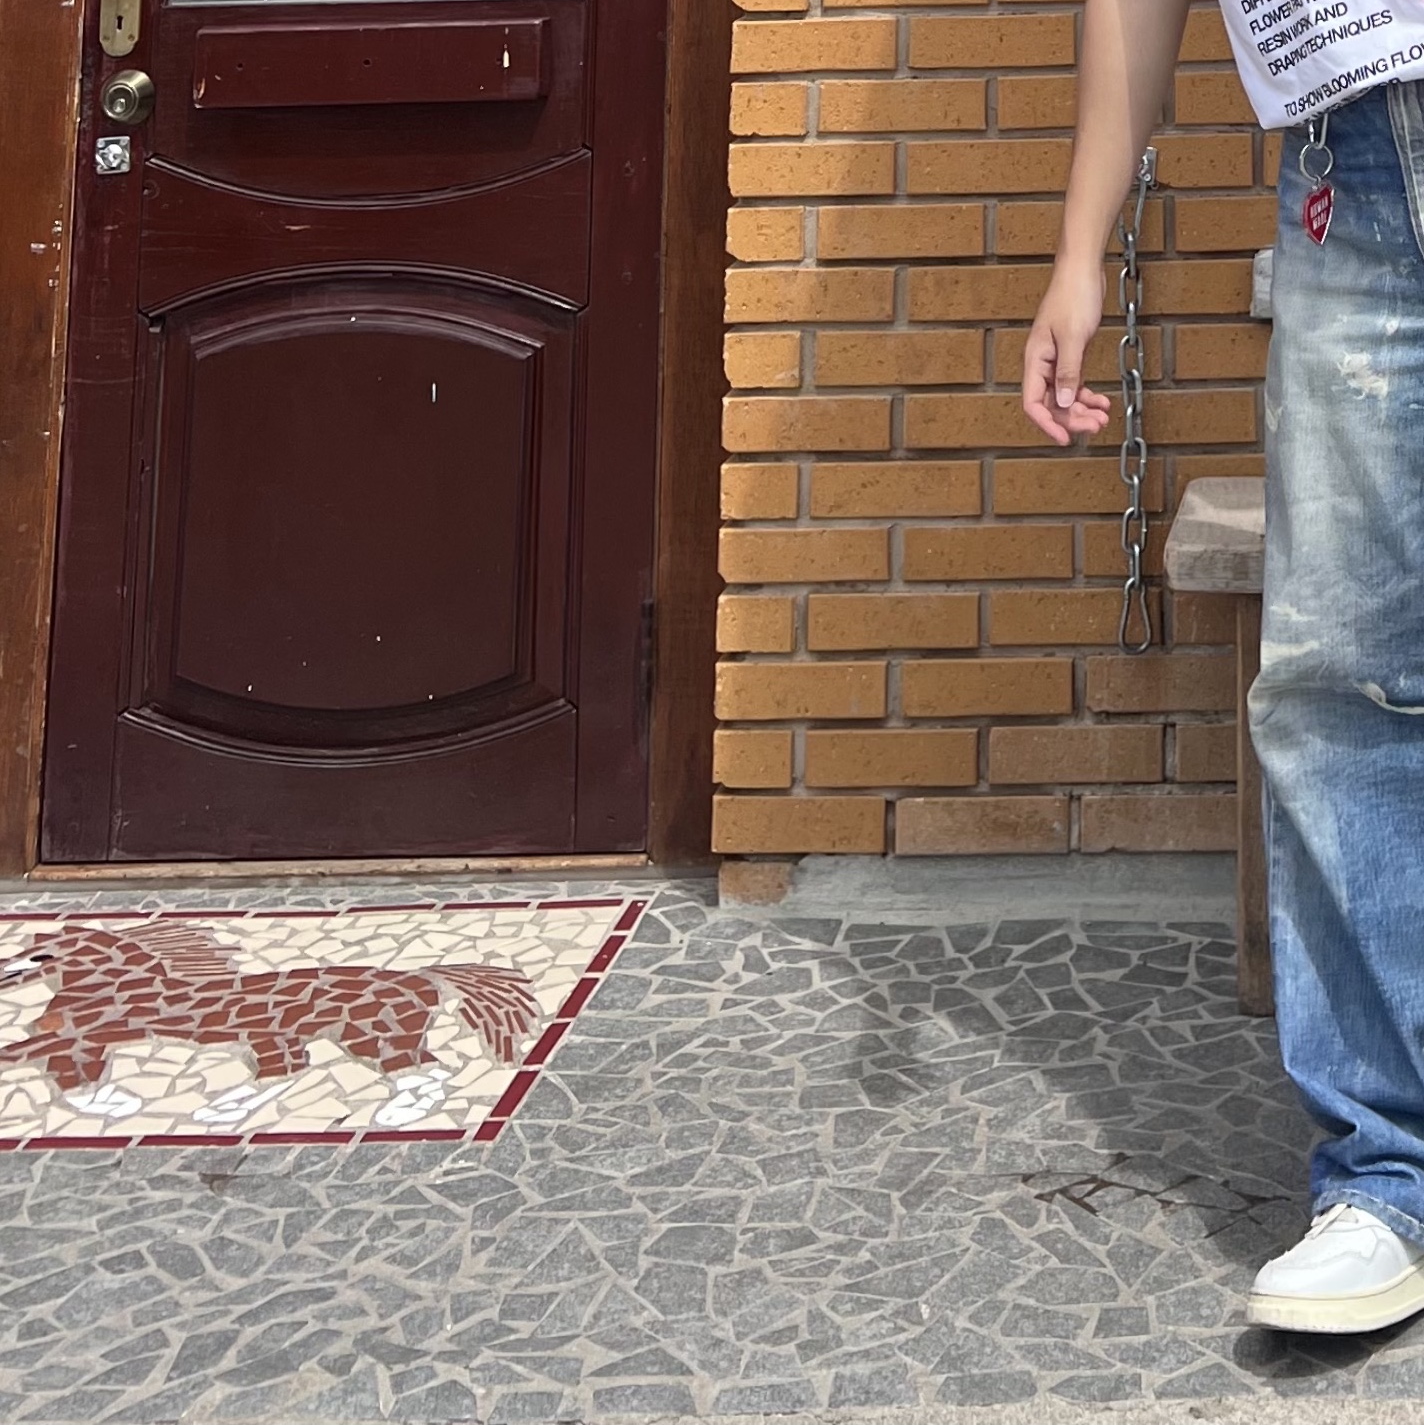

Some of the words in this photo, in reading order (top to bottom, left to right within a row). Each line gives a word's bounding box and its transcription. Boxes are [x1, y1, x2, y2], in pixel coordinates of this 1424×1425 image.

[1256, 27, 1293, 57] RESIN
[1314, 2, 1349, 25] AND
[1267, 44, 1308, 77] DRAPING
[1304, 9, 1394, 55] TECHNIQUES
[1284, 100, 1298, 119] TO
[1297, 86, 1325, 113] SHOW
[1322, 58, 1390, 98] BLOOMING
